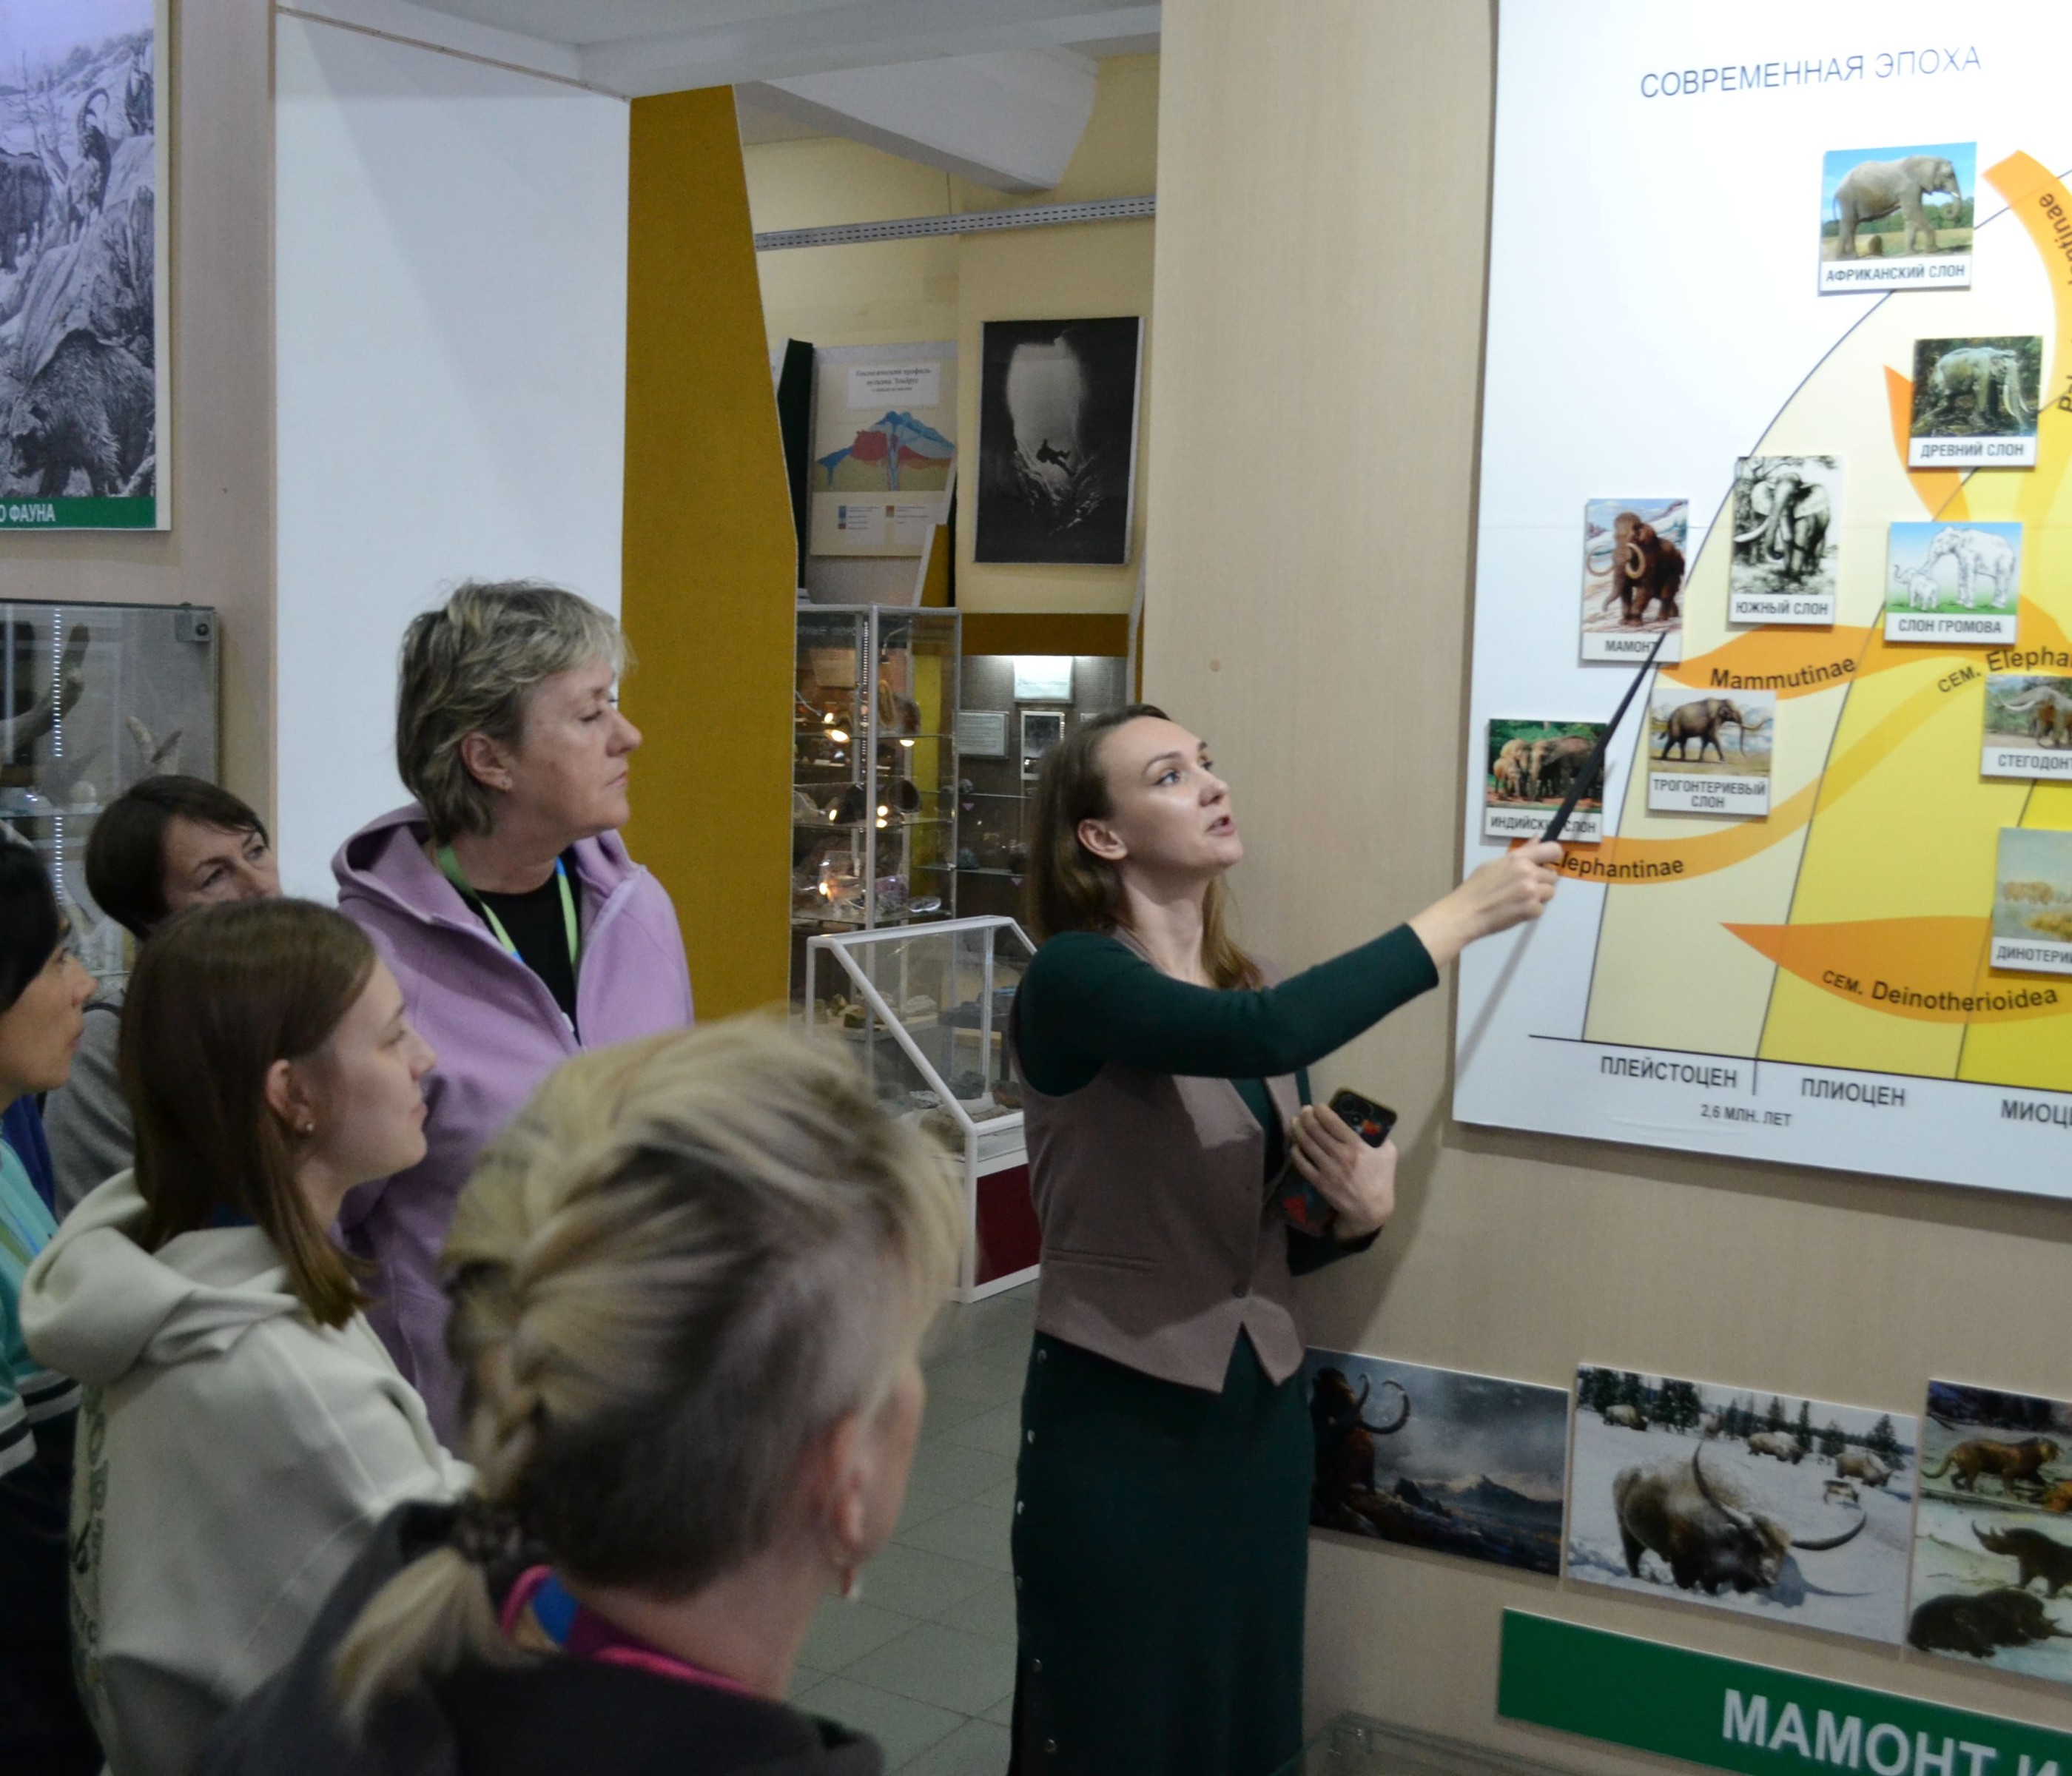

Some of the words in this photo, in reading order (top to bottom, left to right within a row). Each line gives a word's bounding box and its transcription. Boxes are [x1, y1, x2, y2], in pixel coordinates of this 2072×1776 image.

[1640, 56, 1864, 98] СОВРЕМЕННАЯ
[1874, 46, 1982, 78] ЭПОХА
[1826, 264, 1924, 281] АФРИКАНСКИЙ
[1928, 265, 1965, 278] СЛОН
[1920, 441, 1982, 458] ДРЕВНИЙ
[1987, 443, 2024, 456] СЛОН
[9, 504, 56, 522] ФАУНА
[1736, 599, 1790, 615] ЮЖНЫЙ
[1794, 602, 1828, 616] СЛОН
[1899, 619, 1935, 632] СЛОН
[1938, 620, 2002, 634] ГРОМОВА
[1710, 658, 1856, 690] Mammutinae
[1937, 666, 1982, 693] СЕМ.
[1985, 645, 2072, 672] Elepha
[1652, 778, 1766, 796] ТРОГОНТЕРИЕВЫЙ
[1691, 796, 1725, 809] СЛОН
[1490, 815, 1555, 830] ИНДИЙСК
[1564, 820, 1597, 833] СЛОН
[1552, 850, 1684, 879] lephantinae
[1997, 945, 2072, 964] ДИНОТЕРИ
[1822, 969, 1863, 995] СЕМ.
[1871, 980, 2059, 1012] Deinotherioidea
[1601, 1055, 1738, 1089] ПЛЕЙСТОЦЕН
[1800, 1077, 1906, 1107] ПЛИОЦЕН
[1701, 1104, 1720, 1120] 2,6
[1723, 1106, 1760, 1124] МЛН.
[1763, 1111, 1793, 1127] ЛЕТ
[2001, 1099, 2072, 1130] МИОЦ
[1722, 1688, 1997, 1776] МАМОНТ
